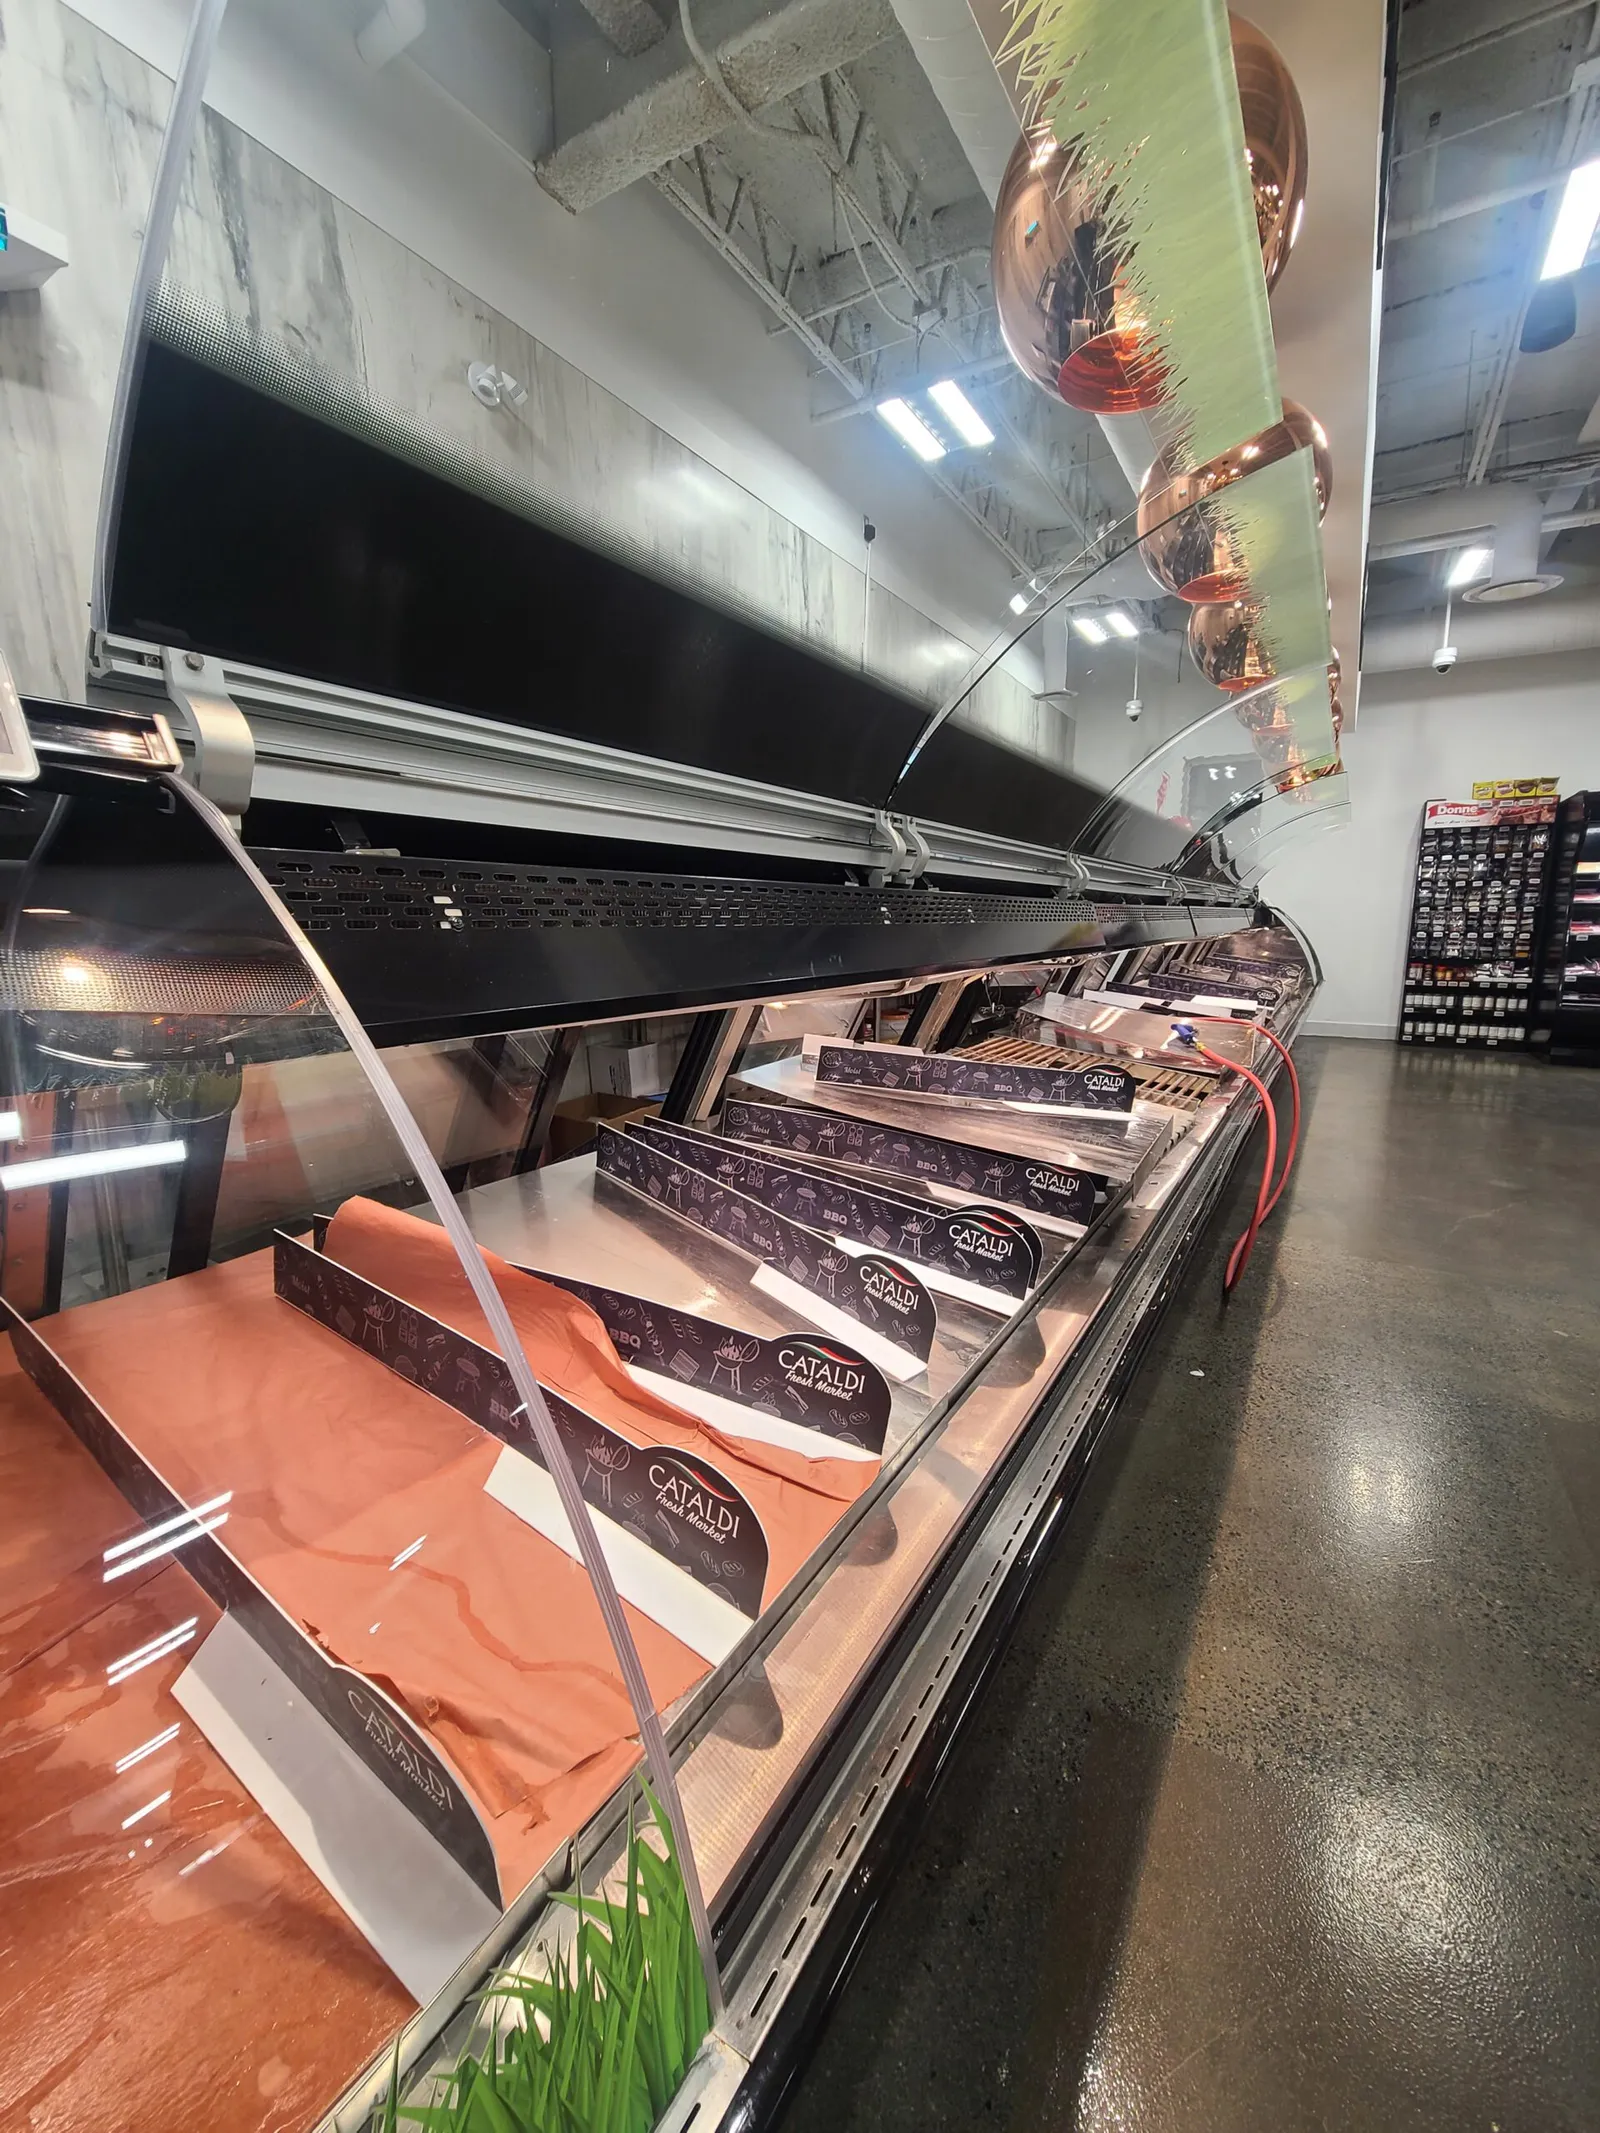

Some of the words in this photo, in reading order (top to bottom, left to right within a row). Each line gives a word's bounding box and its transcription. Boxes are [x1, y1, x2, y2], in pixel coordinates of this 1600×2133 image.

[993, 1083, 1013, 1092] BBQ
[1084, 1074, 1125, 1087] CATALDI
[916, 1159, 938, 1173] BBQ
[1025, 1168, 1080, 1192] CATALDI
[1029, 1178, 1047, 1191] Fresh
[1047, 1184, 1072, 1197] Market
[822, 1209, 848, 1225] BBQ
[752, 1232, 773, 1252] BBQ
[948, 1224, 1014, 1257] CATALDI
[953, 1239, 975, 1252] Fresh
[975, 1246, 1004, 1262] Market
[860, 1265, 919, 1310] CATALDI
[863, 1283, 883, 1301] Fresh
[883, 1294, 910, 1315] Market
[609, 1327, 641, 1349] BBQ
[778, 1349, 865, 1394] CATALDI
[785, 1370, 814, 1388] Fresh
[814, 1380, 854, 1401] Market
[489, 1398, 520, 1430] BBQ
[649, 1464, 740, 1539] CATALDI
[655, 1491, 685, 1518] Fresh
[685, 1511, 727, 1544] Market
[348, 1690, 453, 1811] CATALDI
[365, 1722, 398, 1762] Fresh
[400, 1759, 446, 1811] Market
